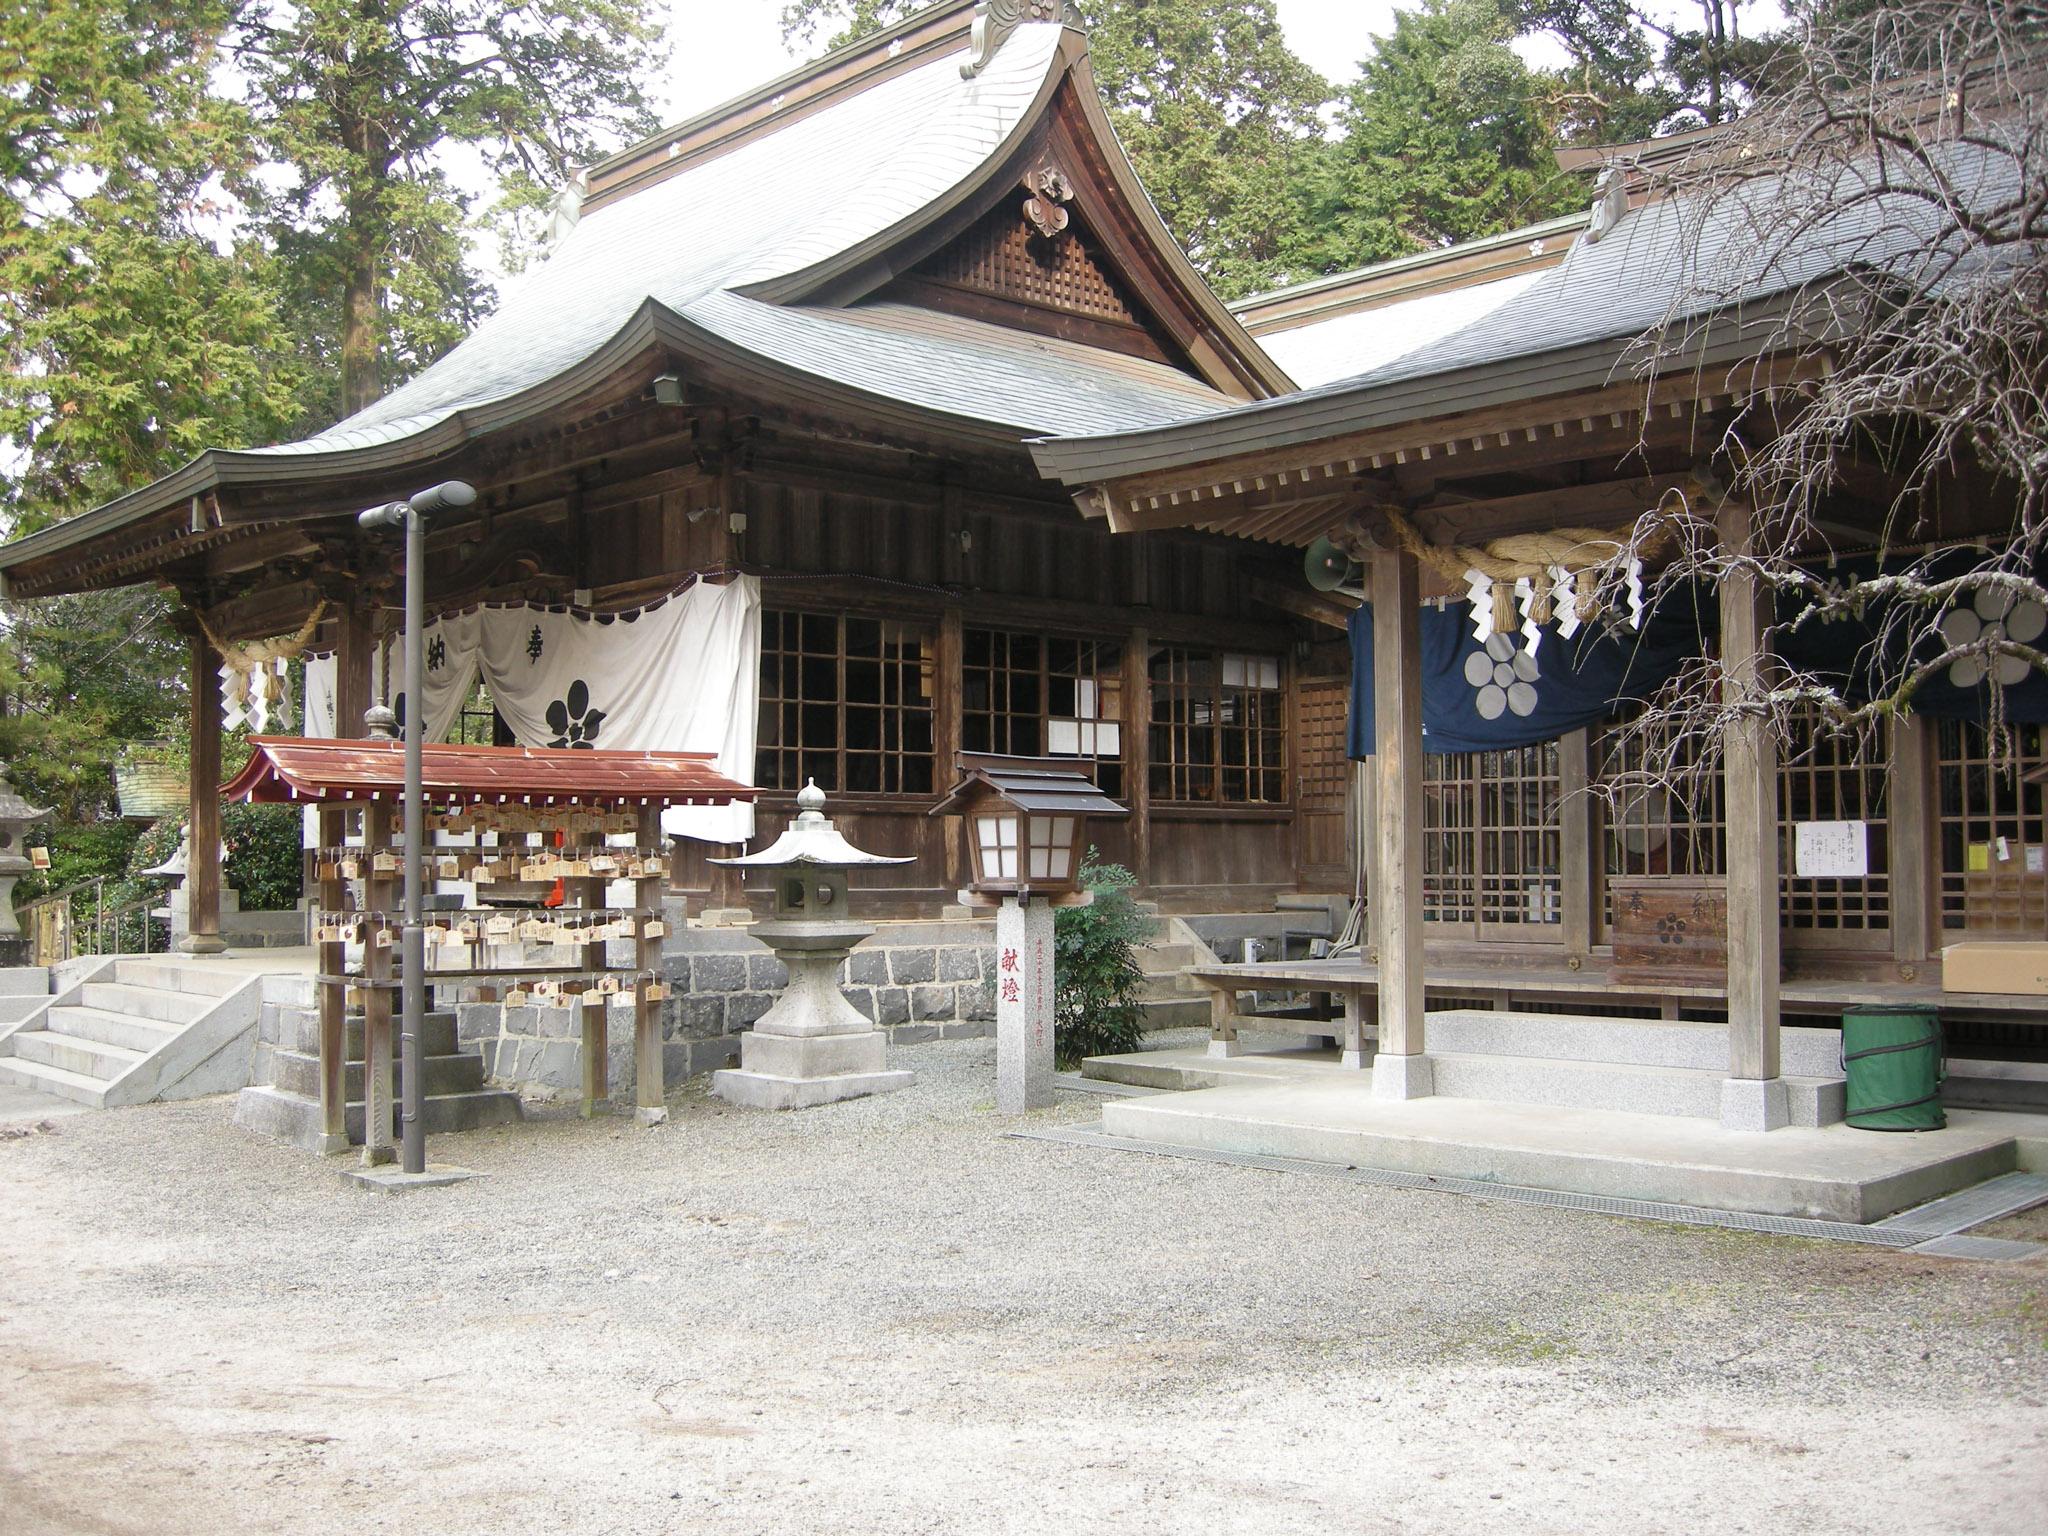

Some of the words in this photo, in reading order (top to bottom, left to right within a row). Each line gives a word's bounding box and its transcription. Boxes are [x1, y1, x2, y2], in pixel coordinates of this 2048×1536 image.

[428, 633, 445, 672] 納
[526, 624, 543, 665] 奉
[1628, 890, 1645, 917] 奉
